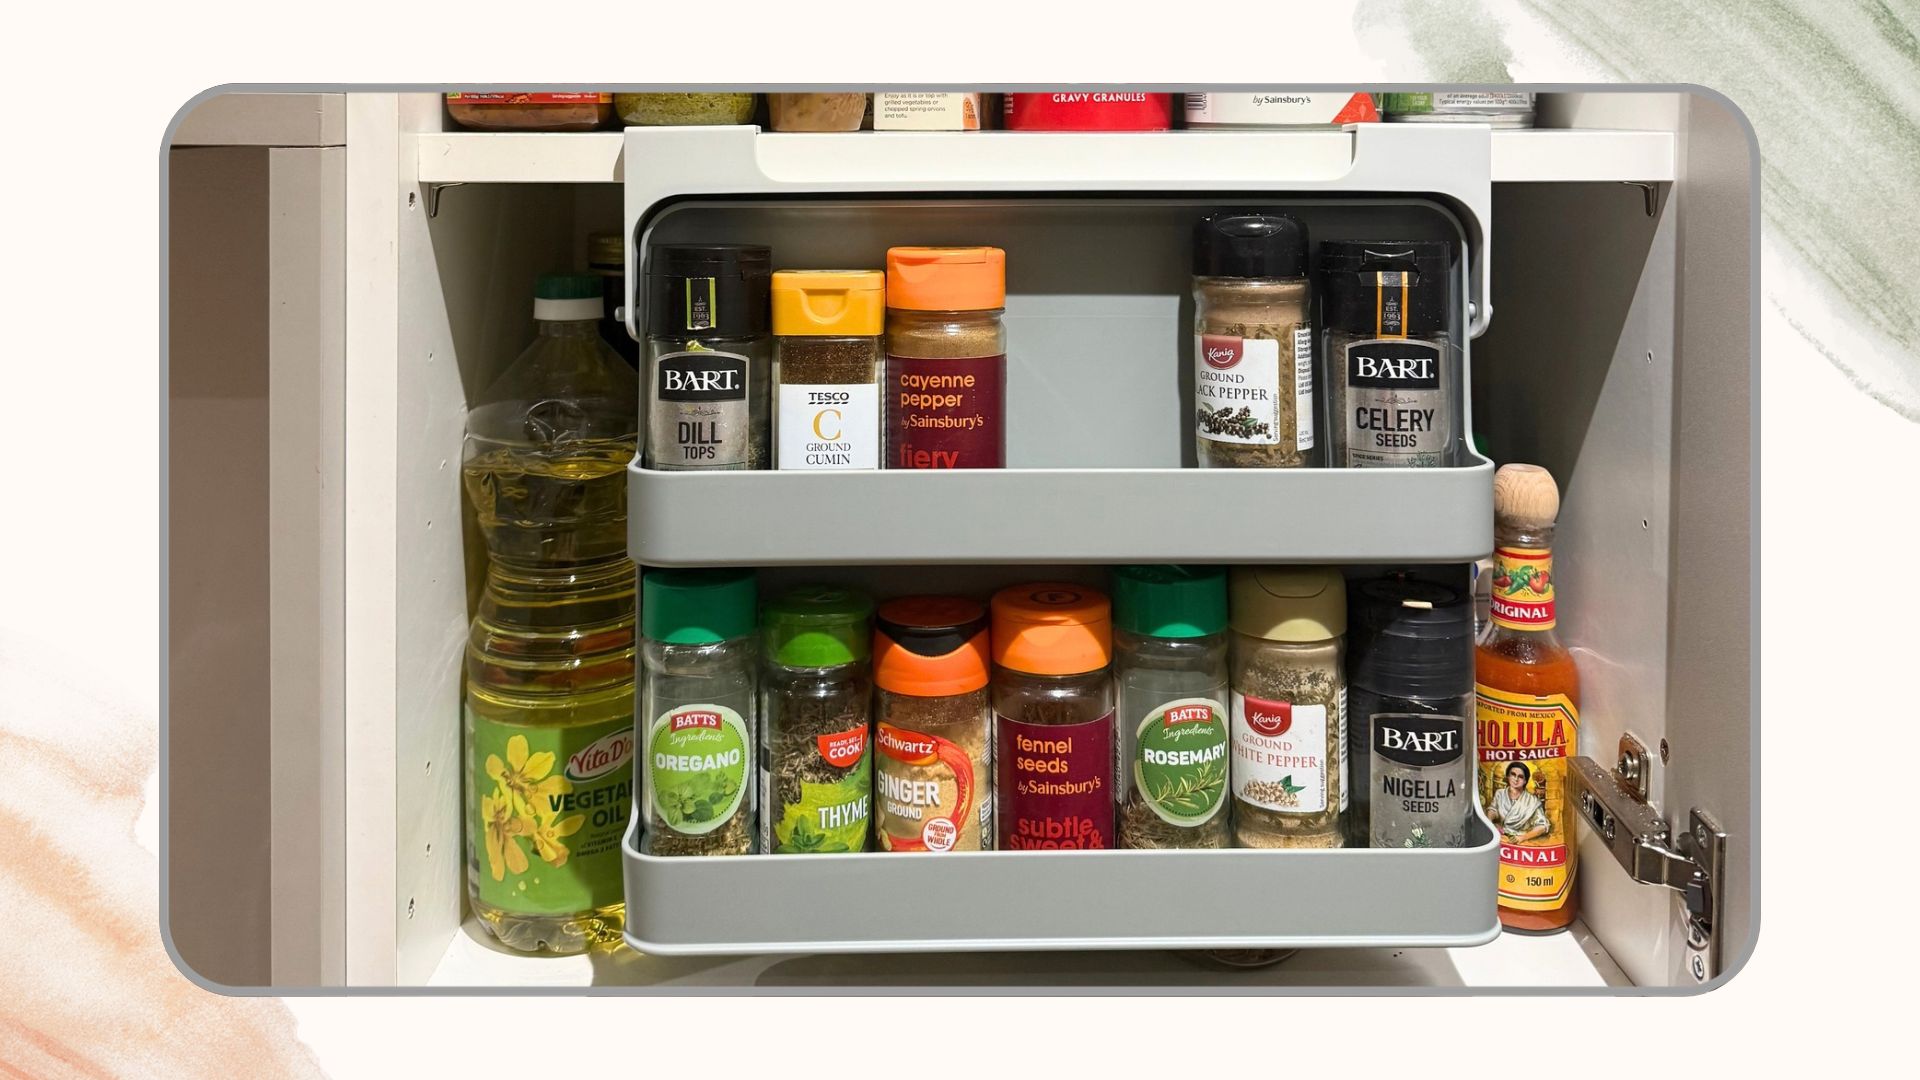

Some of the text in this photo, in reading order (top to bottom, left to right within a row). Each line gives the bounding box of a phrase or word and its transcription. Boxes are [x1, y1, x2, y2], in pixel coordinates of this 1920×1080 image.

[1052, 92, 1146, 103] GRAVY GRANULES
[1253, 96, 1311, 106] by Sainsbury's
[1384, 313, 1401, 321] 1963
[1208, 347, 1235, 361] Kania
[900, 374, 975, 391] cayenne
[1200, 371, 1245, 384] GROUND
[808, 392, 849, 401] TESCO
[901, 392, 963, 410] pepper
[1219, 387, 1269, 401] PEPPER
[813, 408, 841, 441] C
[901, 413, 984, 430] by Sainsbury's
[1355, 406, 1435, 432] CELERY
[678, 421, 722, 445] DILL
[1375, 433, 1417, 448] SEEDS
[683, 446, 715, 460] TOPS
[806, 442, 851, 452] GROUND
[806, 454, 850, 465] CUMIN
[675, 713, 717, 728] BATTS
[1170, 708, 1209, 722] BATTS
[1252, 712, 1282, 726] Kania
[1507, 710, 1527, 718] FROM
[670, 730, 725, 748] Ingredients
[1163, 723, 1215, 742] Ingredients
[878, 728, 933, 754] Schwartz
[1017, 735, 1072, 755] fennel
[1242, 733, 1293, 752] GROUND
[571, 743, 609, 774] Vita
[655, 748, 740, 772] OREGANO
[1144, 740, 1226, 766] ROSEMARY
[1267, 753, 1318, 769] PEPPER
[1485, 747, 1560, 761] HOT SAUCE
[1017, 758, 1068, 774] seeds
[877, 770, 941, 806] GINGER
[1017, 775, 1101, 795] by Sainsbury's
[1383, 775, 1456, 799] NIGELLA
[818, 794, 868, 829] THYME
[887, 801, 922, 820] GROUND
[1402, 799, 1440, 813] SEEDS
[592, 805, 625, 828] OIL
[927, 823, 954, 835] GROUND
[1018, 815, 1094, 839] subtle
[927, 835, 951, 846] WHOLE
[1089, 829, 1105, 850] &
[1526, 876, 1553, 886] 150 ml
